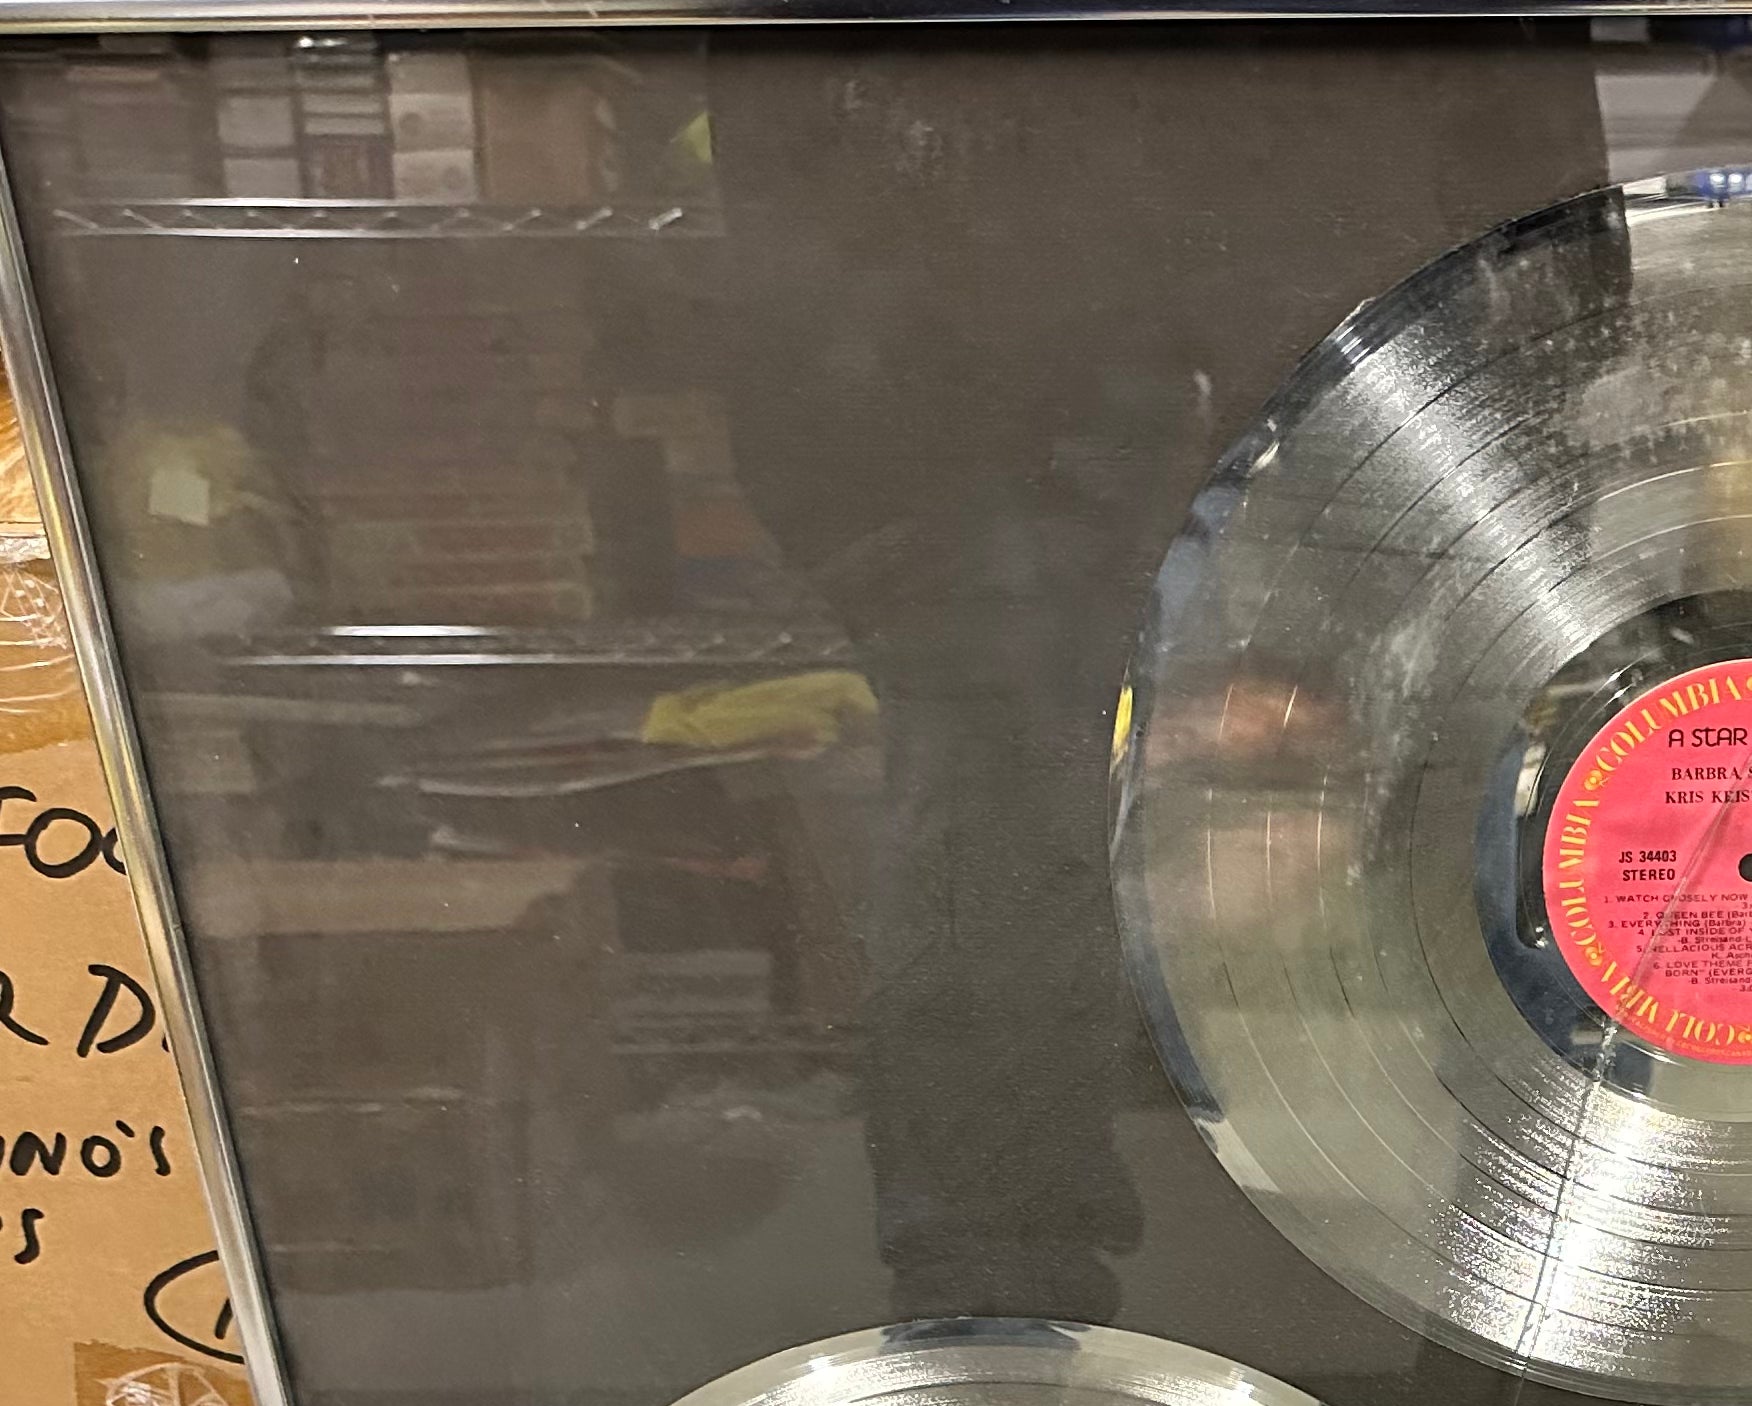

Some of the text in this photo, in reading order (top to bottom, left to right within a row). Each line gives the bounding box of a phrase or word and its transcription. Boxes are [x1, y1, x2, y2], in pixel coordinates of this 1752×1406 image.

[1599, 675, 1742, 774] COLUMBIA
[1668, 728, 1684, 748] A
[1692, 727, 1748, 748] STAR
[1671, 766, 1741, 782] BARBRA
[1665, 790, 1704, 805] KRIS
[1618, 850, 1678, 864] JS 34403
[1559, 799, 1599, 946] COLUMBIA
[1622, 868, 1676, 882] STEREO
[1616, 893, 1659, 902] WATCH
[1721, 892, 1748, 902] NOW
[1685, 927, 1727, 936] INSIDE
[1729, 926, 1742, 935] OF
[1666, 960, 1699, 970] LOVE
[1703, 959, 1744, 969] THEME
[0, 1119, 171, 1178] NO'S
